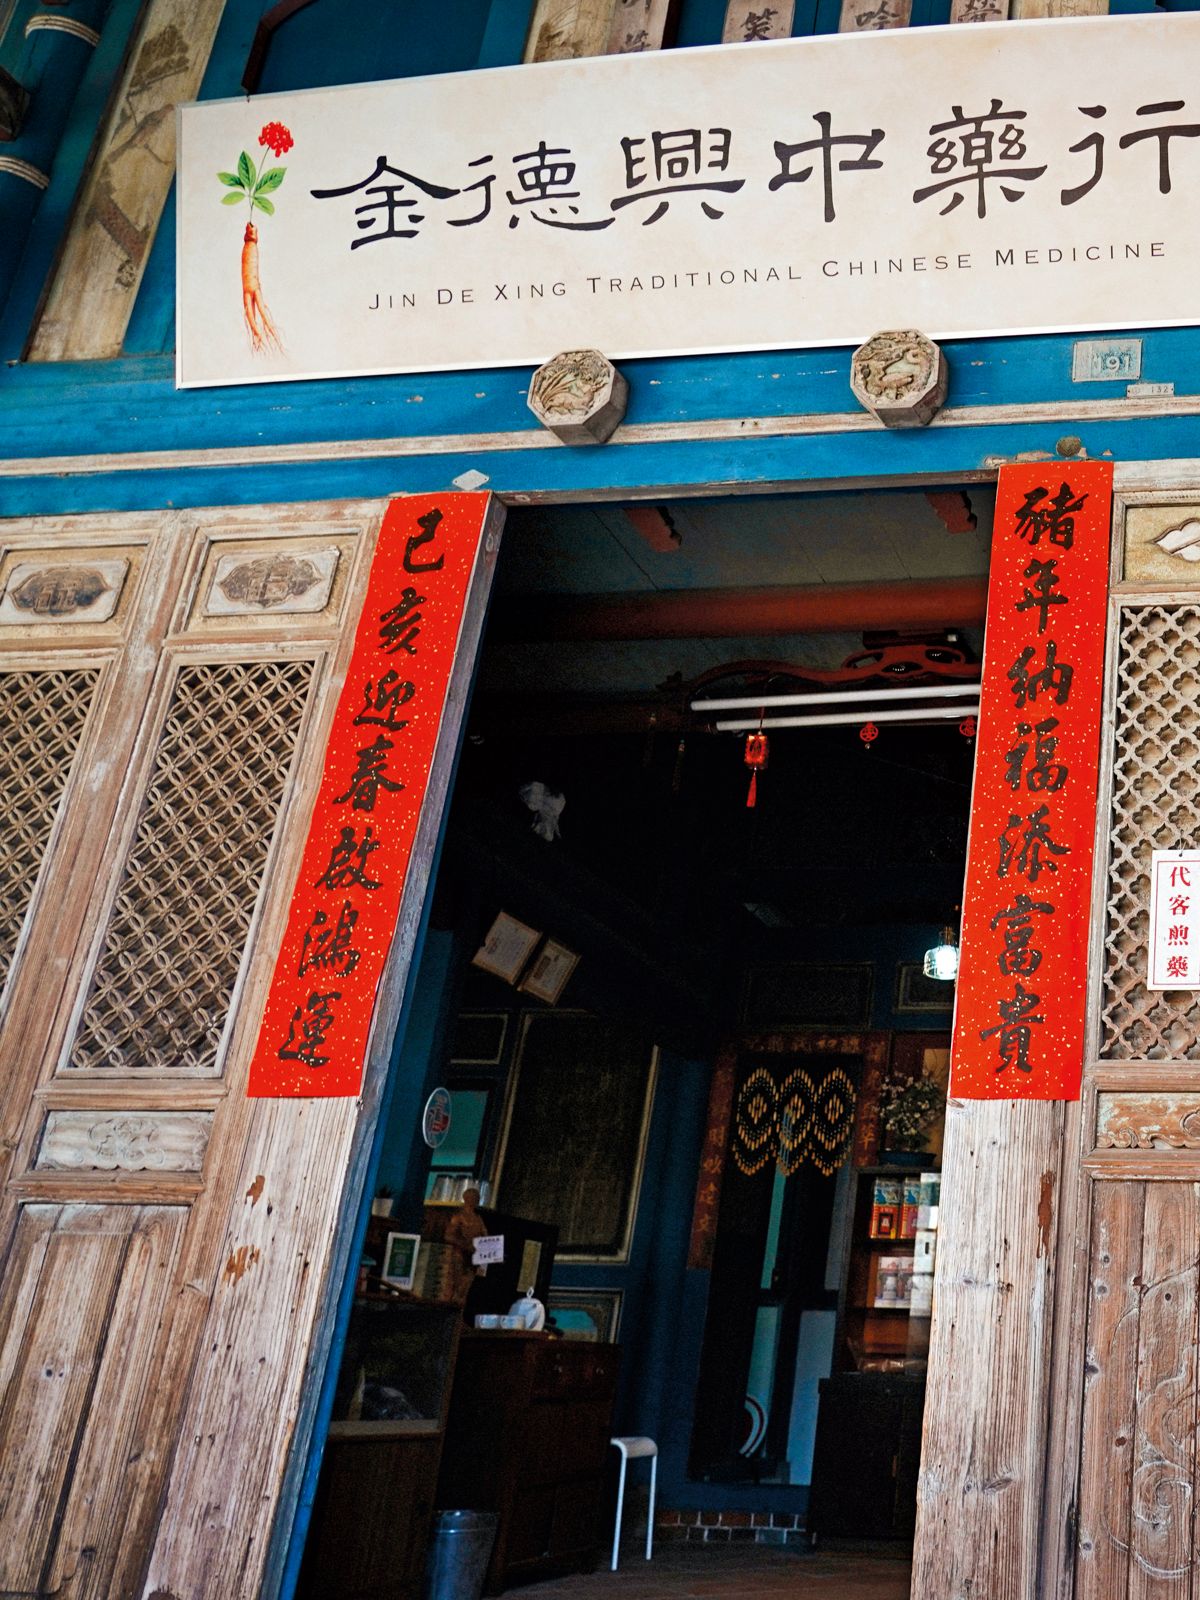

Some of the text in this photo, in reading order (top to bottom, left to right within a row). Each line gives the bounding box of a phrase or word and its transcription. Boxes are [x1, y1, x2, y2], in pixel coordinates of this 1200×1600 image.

[369, 242, 1165, 310] JIN DE XING TRADITIONAL CHINESE MEDICINE
[979, 482, 1089, 1074] 豬年納福添富貴
[1167, 866, 1192, 978] 代客煎藥
